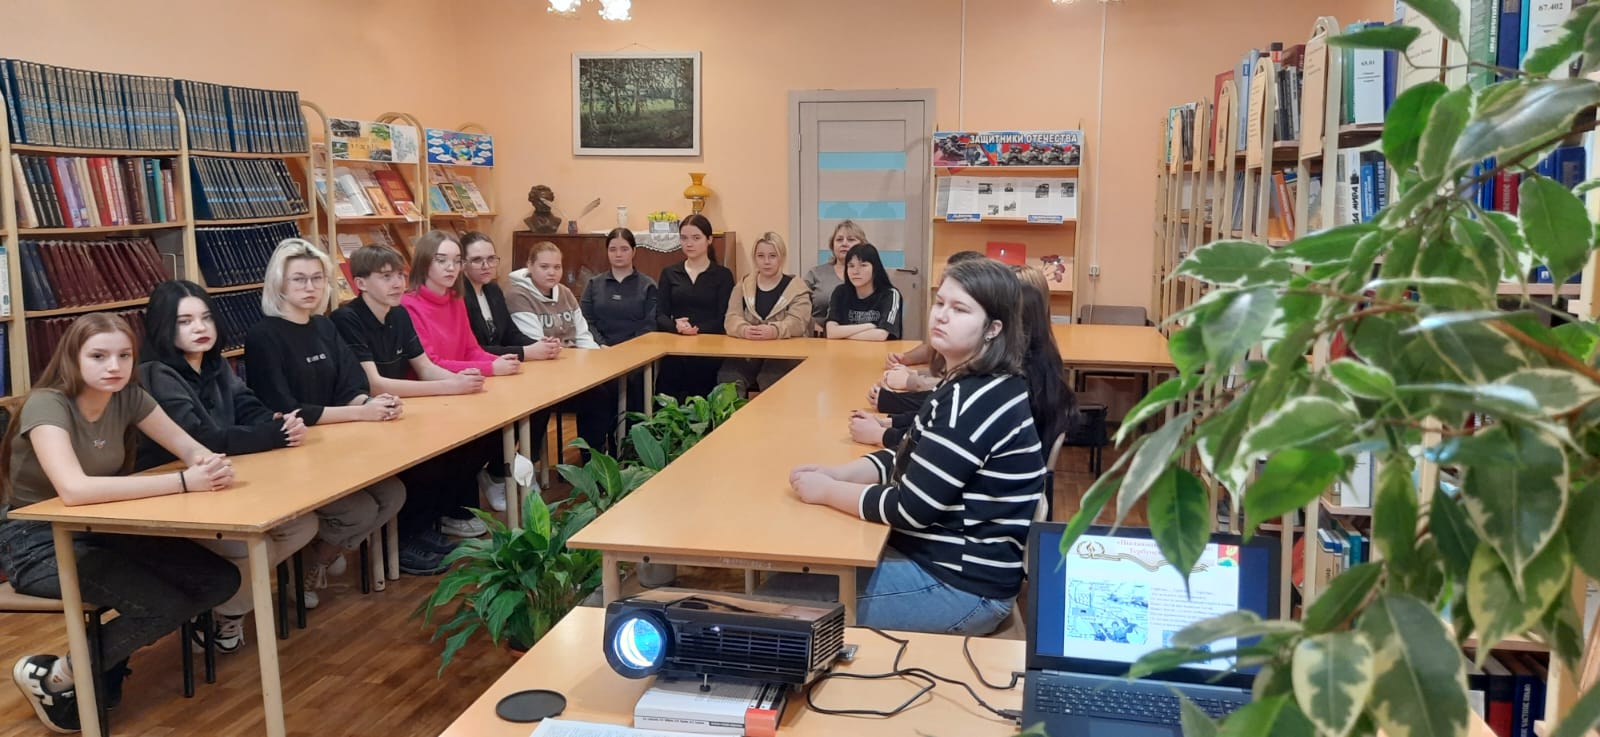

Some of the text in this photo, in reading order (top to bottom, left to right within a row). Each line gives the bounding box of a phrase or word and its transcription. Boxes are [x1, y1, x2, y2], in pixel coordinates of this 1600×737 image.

[1538, 2, 1564, 11] 67.402
[970, 134, 1077, 144] ЗАЩИТНИКИ ОТЕЧЕСТВА
